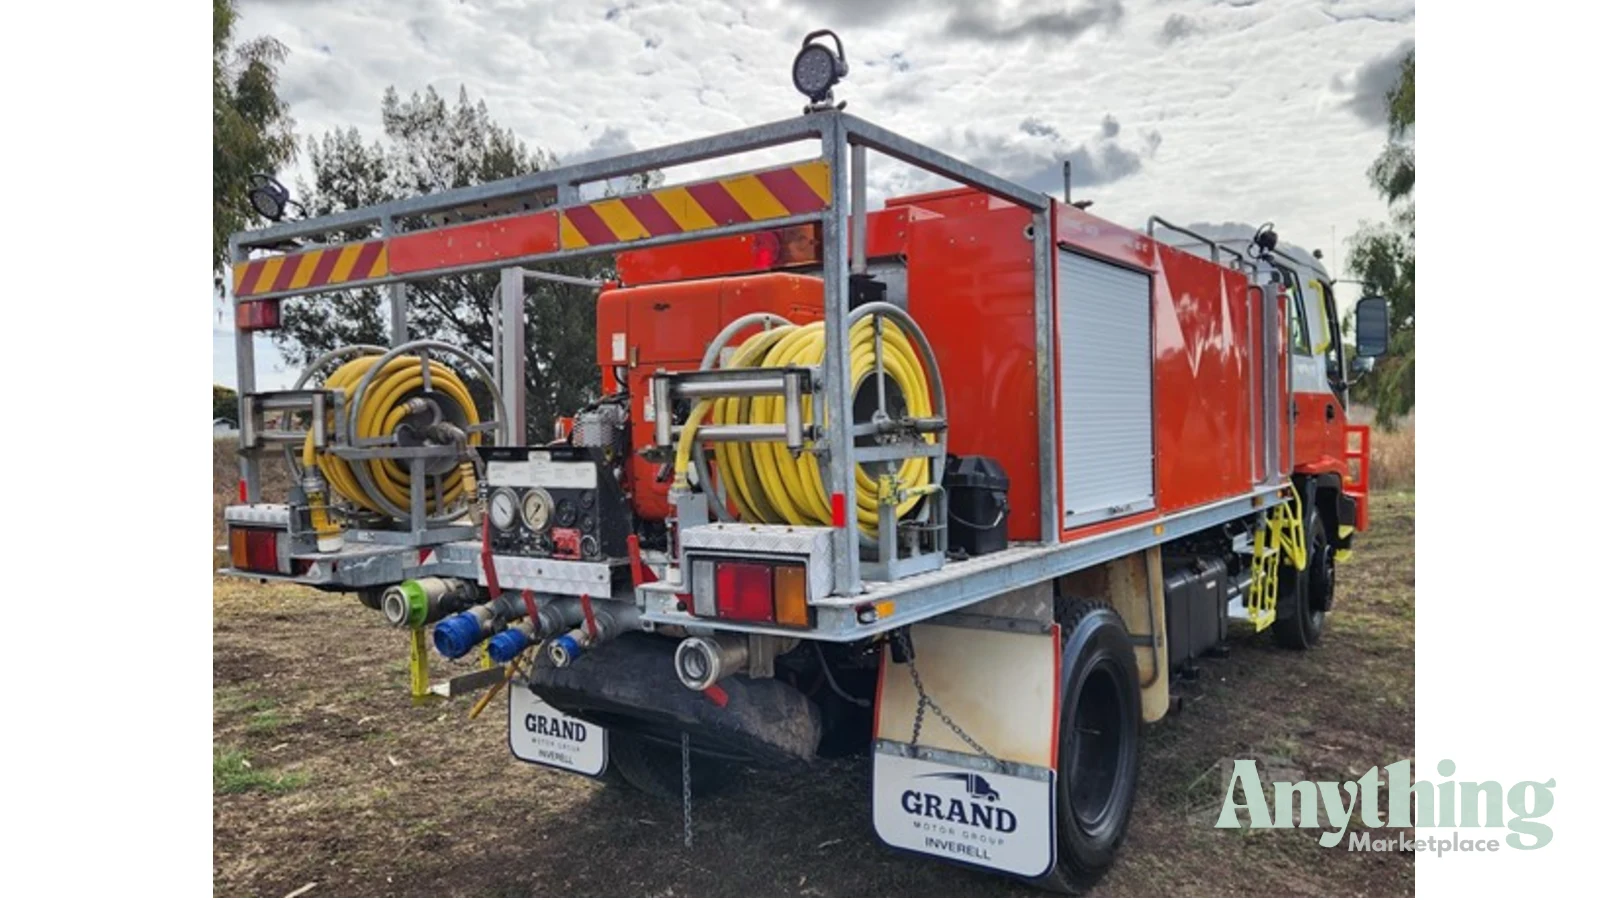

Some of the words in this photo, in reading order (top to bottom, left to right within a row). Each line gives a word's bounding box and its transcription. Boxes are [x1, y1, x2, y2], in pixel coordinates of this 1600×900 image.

[525, 713, 587, 742] GRAND
[901, 790, 1017, 833] GRAND
[913, 821, 956, 836] MOTOR
[962, 830, 1005, 846] GROUP
[925, 836, 991, 861] INVERELL
